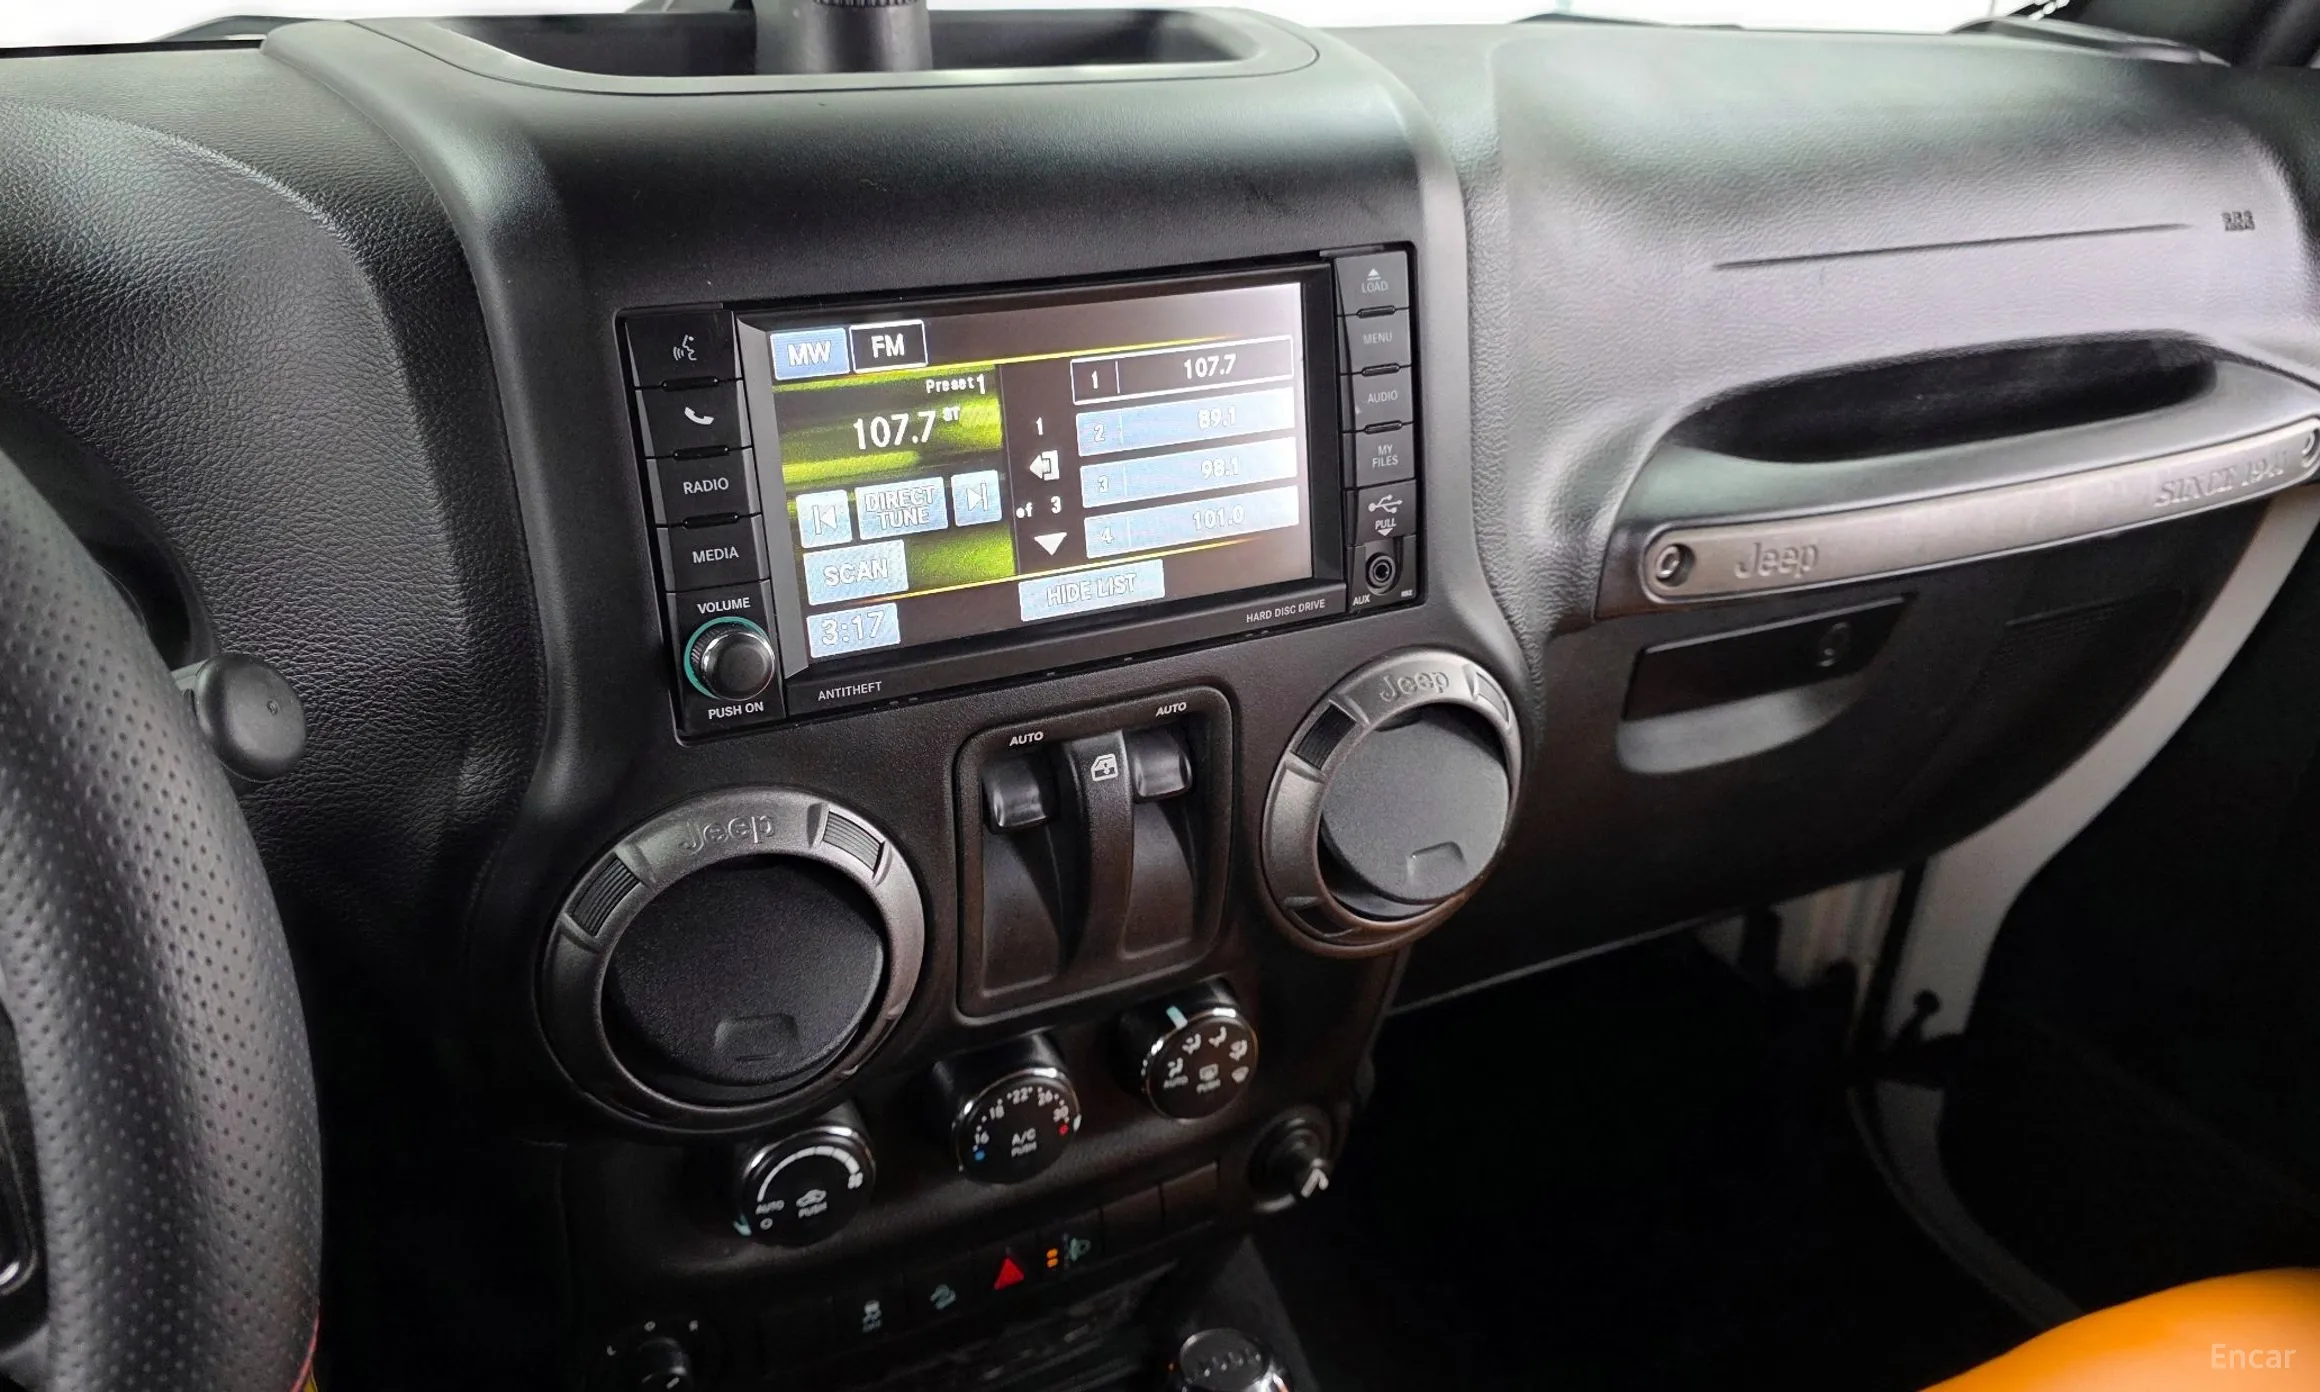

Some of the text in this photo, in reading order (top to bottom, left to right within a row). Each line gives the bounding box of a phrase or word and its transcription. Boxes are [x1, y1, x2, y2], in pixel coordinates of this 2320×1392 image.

[1361, 281, 1389, 294] LOAD
[787, 333, 905, 366] MW FM
[1363, 332, 1393, 345] MENU
[1091, 354, 1237, 389] 1 107.7
[926, 373, 986, 395] Preset 1
[1367, 390, 1399, 404] AUDIO
[853, 410, 936, 450] 107.7
[1035, 416, 1044, 436] 1
[1093, 406, 1237, 441] 2 89.1
[1378, 444, 1393, 455] MY
[1372, 455, 1399, 468] FILES
[683, 477, 729, 494] RADIO
[1099, 456, 1240, 493] 3 98.1
[865, 485, 935, 513] DIRECT
[1015, 496, 1062, 518] of 3
[876, 507, 930, 530] TUNE
[1101, 504, 1245, 544] 4 101.0
[1375, 517, 1397, 530] PULL
[692, 547, 739, 564] MEDIA
[1734, 542, 1818, 580] Jeep
[823, 558, 889, 587] SCAN
[1046, 573, 1137, 607] HIDE LIST
[1353, 594, 1371, 606] AUX
[697, 597, 751, 614] VOLUME
[1246, 599, 1326, 623] HARD DISC DRIVE
[820, 610, 885, 647] 3:17
[818, 681, 882, 701] ANTITHEFT
[1380, 671, 1450, 702] Jeep
[708, 701, 764, 720] PUSH ON
[1157, 701, 1187, 717] AUTO
[1009, 731, 1044, 747] AUTO
[679, 815, 776, 857] Jeep
[1012, 1128, 1036, 1146] A/C
